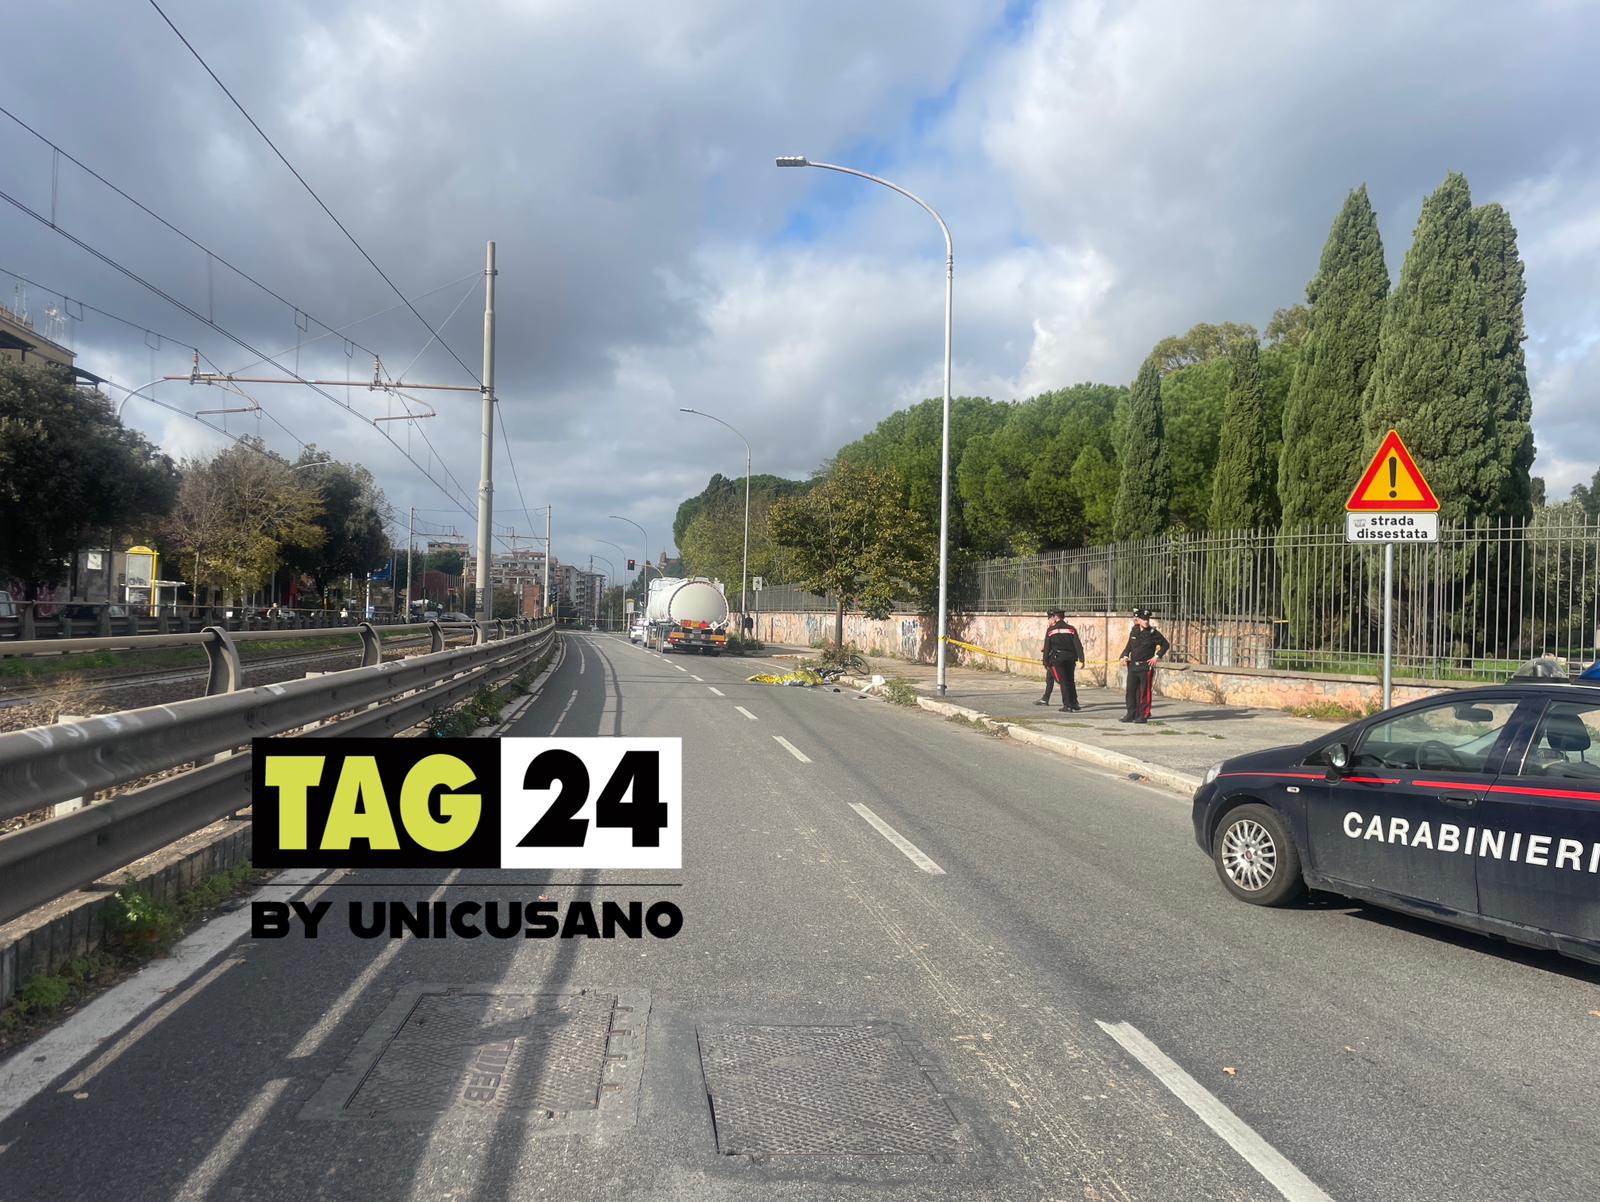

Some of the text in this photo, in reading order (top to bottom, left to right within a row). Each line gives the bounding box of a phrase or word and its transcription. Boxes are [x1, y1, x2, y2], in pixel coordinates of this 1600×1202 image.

[1371, 516, 1414, 526] strada
[1356, 528, 1428, 539] dissestata
[1343, 811, 1600, 873] CARABINIERI
